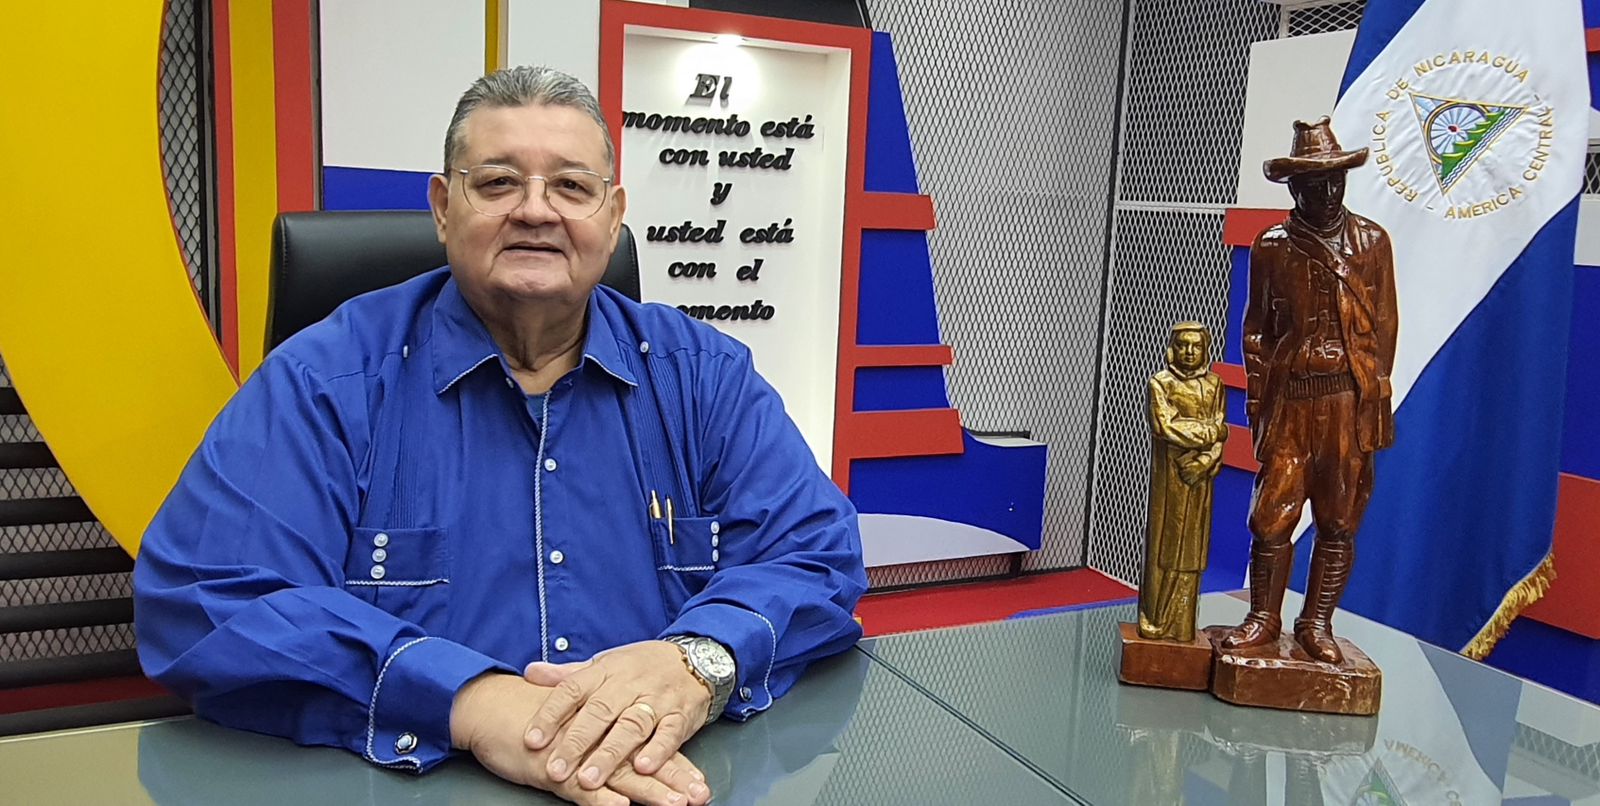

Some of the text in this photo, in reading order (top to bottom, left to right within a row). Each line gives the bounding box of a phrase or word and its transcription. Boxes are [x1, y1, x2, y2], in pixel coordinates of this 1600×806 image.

[689, 73, 733, 100] El
[622, 111, 815, 138] momento está
[1373, 51, 1529, 202] REPUBLICA DE NICARAGUA
[659, 148, 795, 170] con usted
[710, 182, 732, 205] y
[1445, 186, 1522, 219] AMERICA
[646, 218, 794, 243] usted está
[667, 259, 763, 281] con el
